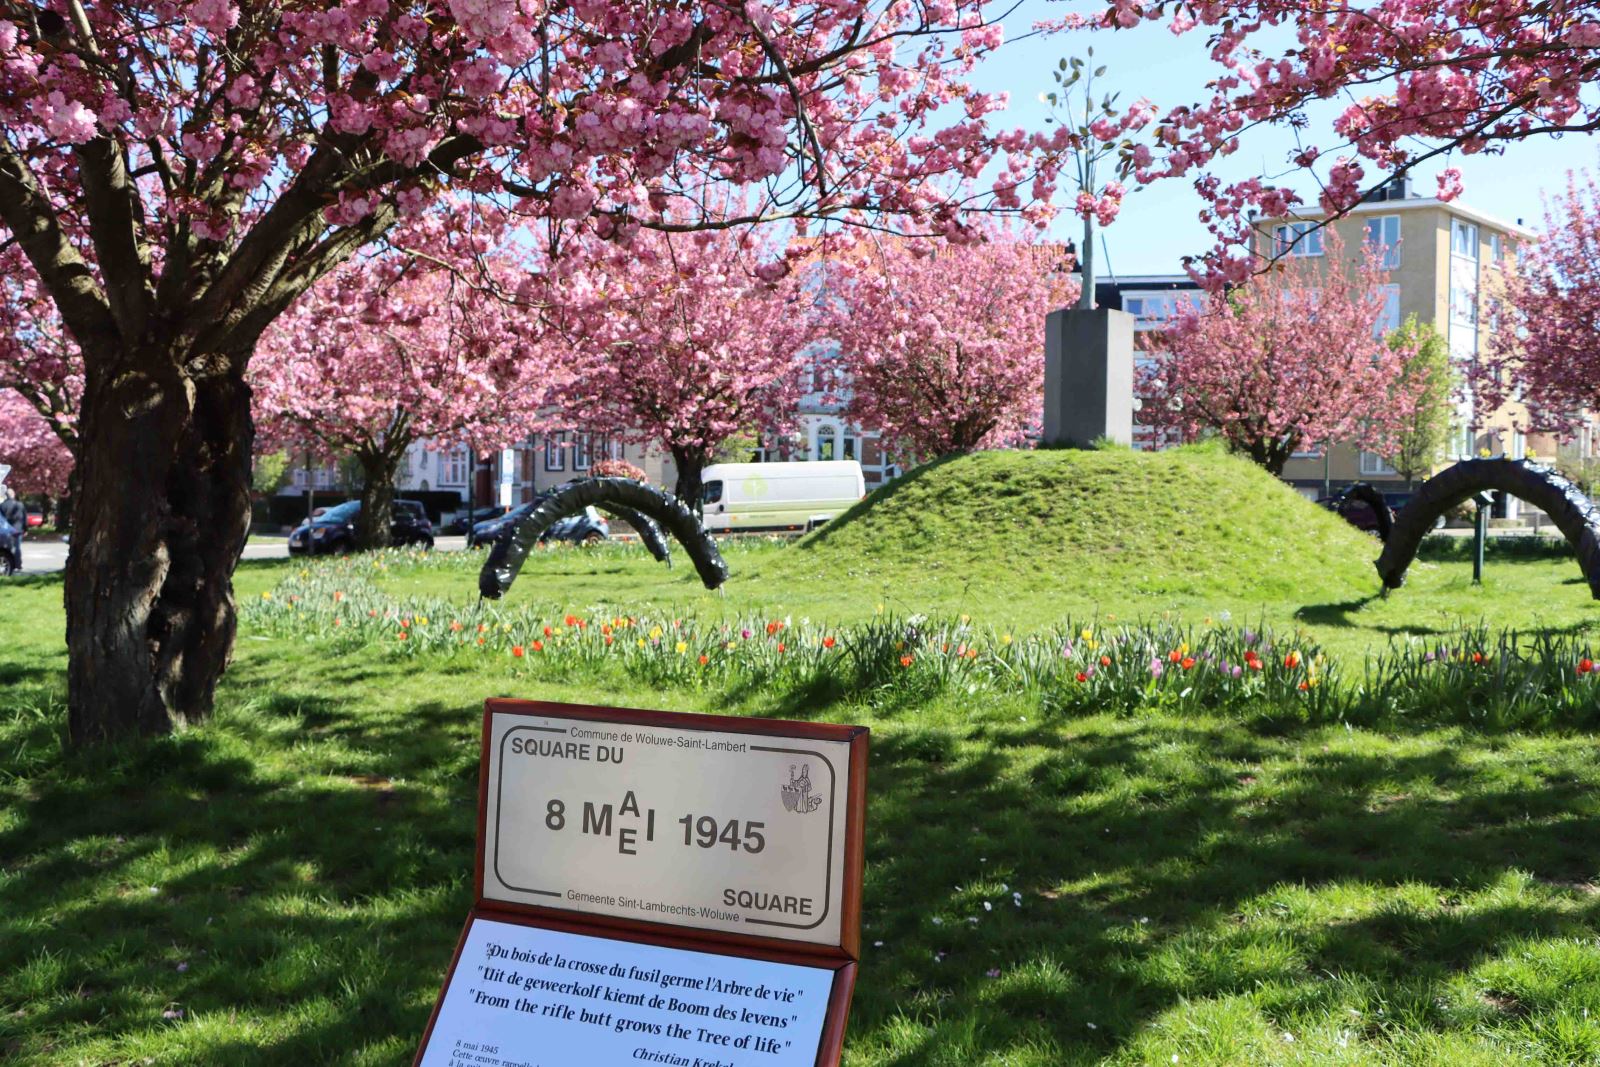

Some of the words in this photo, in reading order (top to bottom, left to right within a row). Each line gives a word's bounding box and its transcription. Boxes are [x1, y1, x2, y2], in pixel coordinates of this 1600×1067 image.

[512, 738, 590, 760] SQUARE
[596, 746, 624, 764] DU
[570, 727, 618, 742] Commune
[620, 731, 632, 744] de
[636, 733, 746, 752] Woluwe-Saint-Lambert
[545, 799, 566, 830] 8
[678, 814, 766, 854] 1945
[567, 889, 616, 906] Gemeente
[618, 896, 740, 922] Sint-Lambrechts-Woluwe
[722, 888, 812, 916] SQUARE
[511, 947, 536, 964] bois
[538, 952, 553, 966] de
[554, 954, 566, 968] la
[568, 959, 608, 975] crosse
[609, 963, 626, 978] du
[628, 966, 660, 983] fusil
[660, 974, 704, 990] germe
[705, 976, 752, 996] l'Arbre
[754, 984, 770, 1000] de
[507, 971, 524, 986] de
[523, 977, 602, 999] geweerkolf
[603, 986, 646, 1007] kiemt
[648, 994, 665, 1010] de
[667, 998, 710, 1016] Boom
[713, 1004, 738, 1021] des
[514, 998, 538, 1014] the
[542, 1004, 576, 1020] rifle
[580, 1008, 612, 1026] butt
[614, 1018, 662, 1035] grows
[666, 1023, 692, 1040] the
[696, 1028, 730, 1046] Tree
[734, 1034, 752, 1049] of
[463, 1042, 478, 1050] mai
[480, 1044, 500, 1054] 1945
[632, 1048, 690, 1067] Christian
